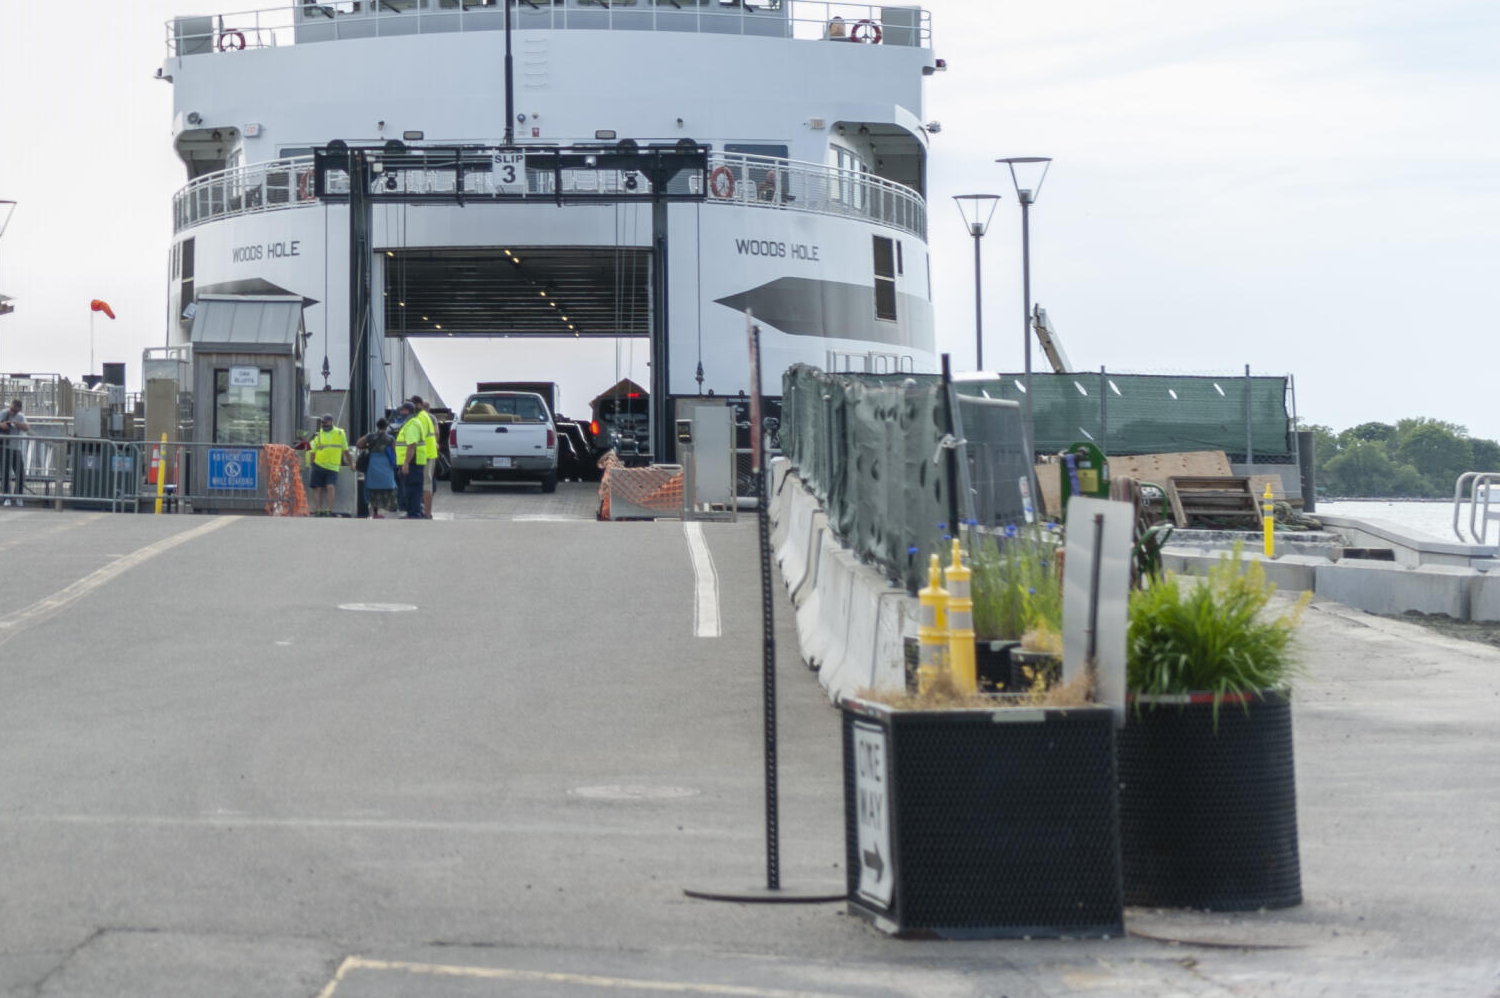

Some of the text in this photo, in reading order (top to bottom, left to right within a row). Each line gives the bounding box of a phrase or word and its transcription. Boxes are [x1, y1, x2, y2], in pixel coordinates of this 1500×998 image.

[495, 154, 524, 163] SLIP
[502, 165, 516, 184] 3
[232, 240, 301, 263] WOODS HOLE
[735, 238, 820, 261] WOODS HOLE
